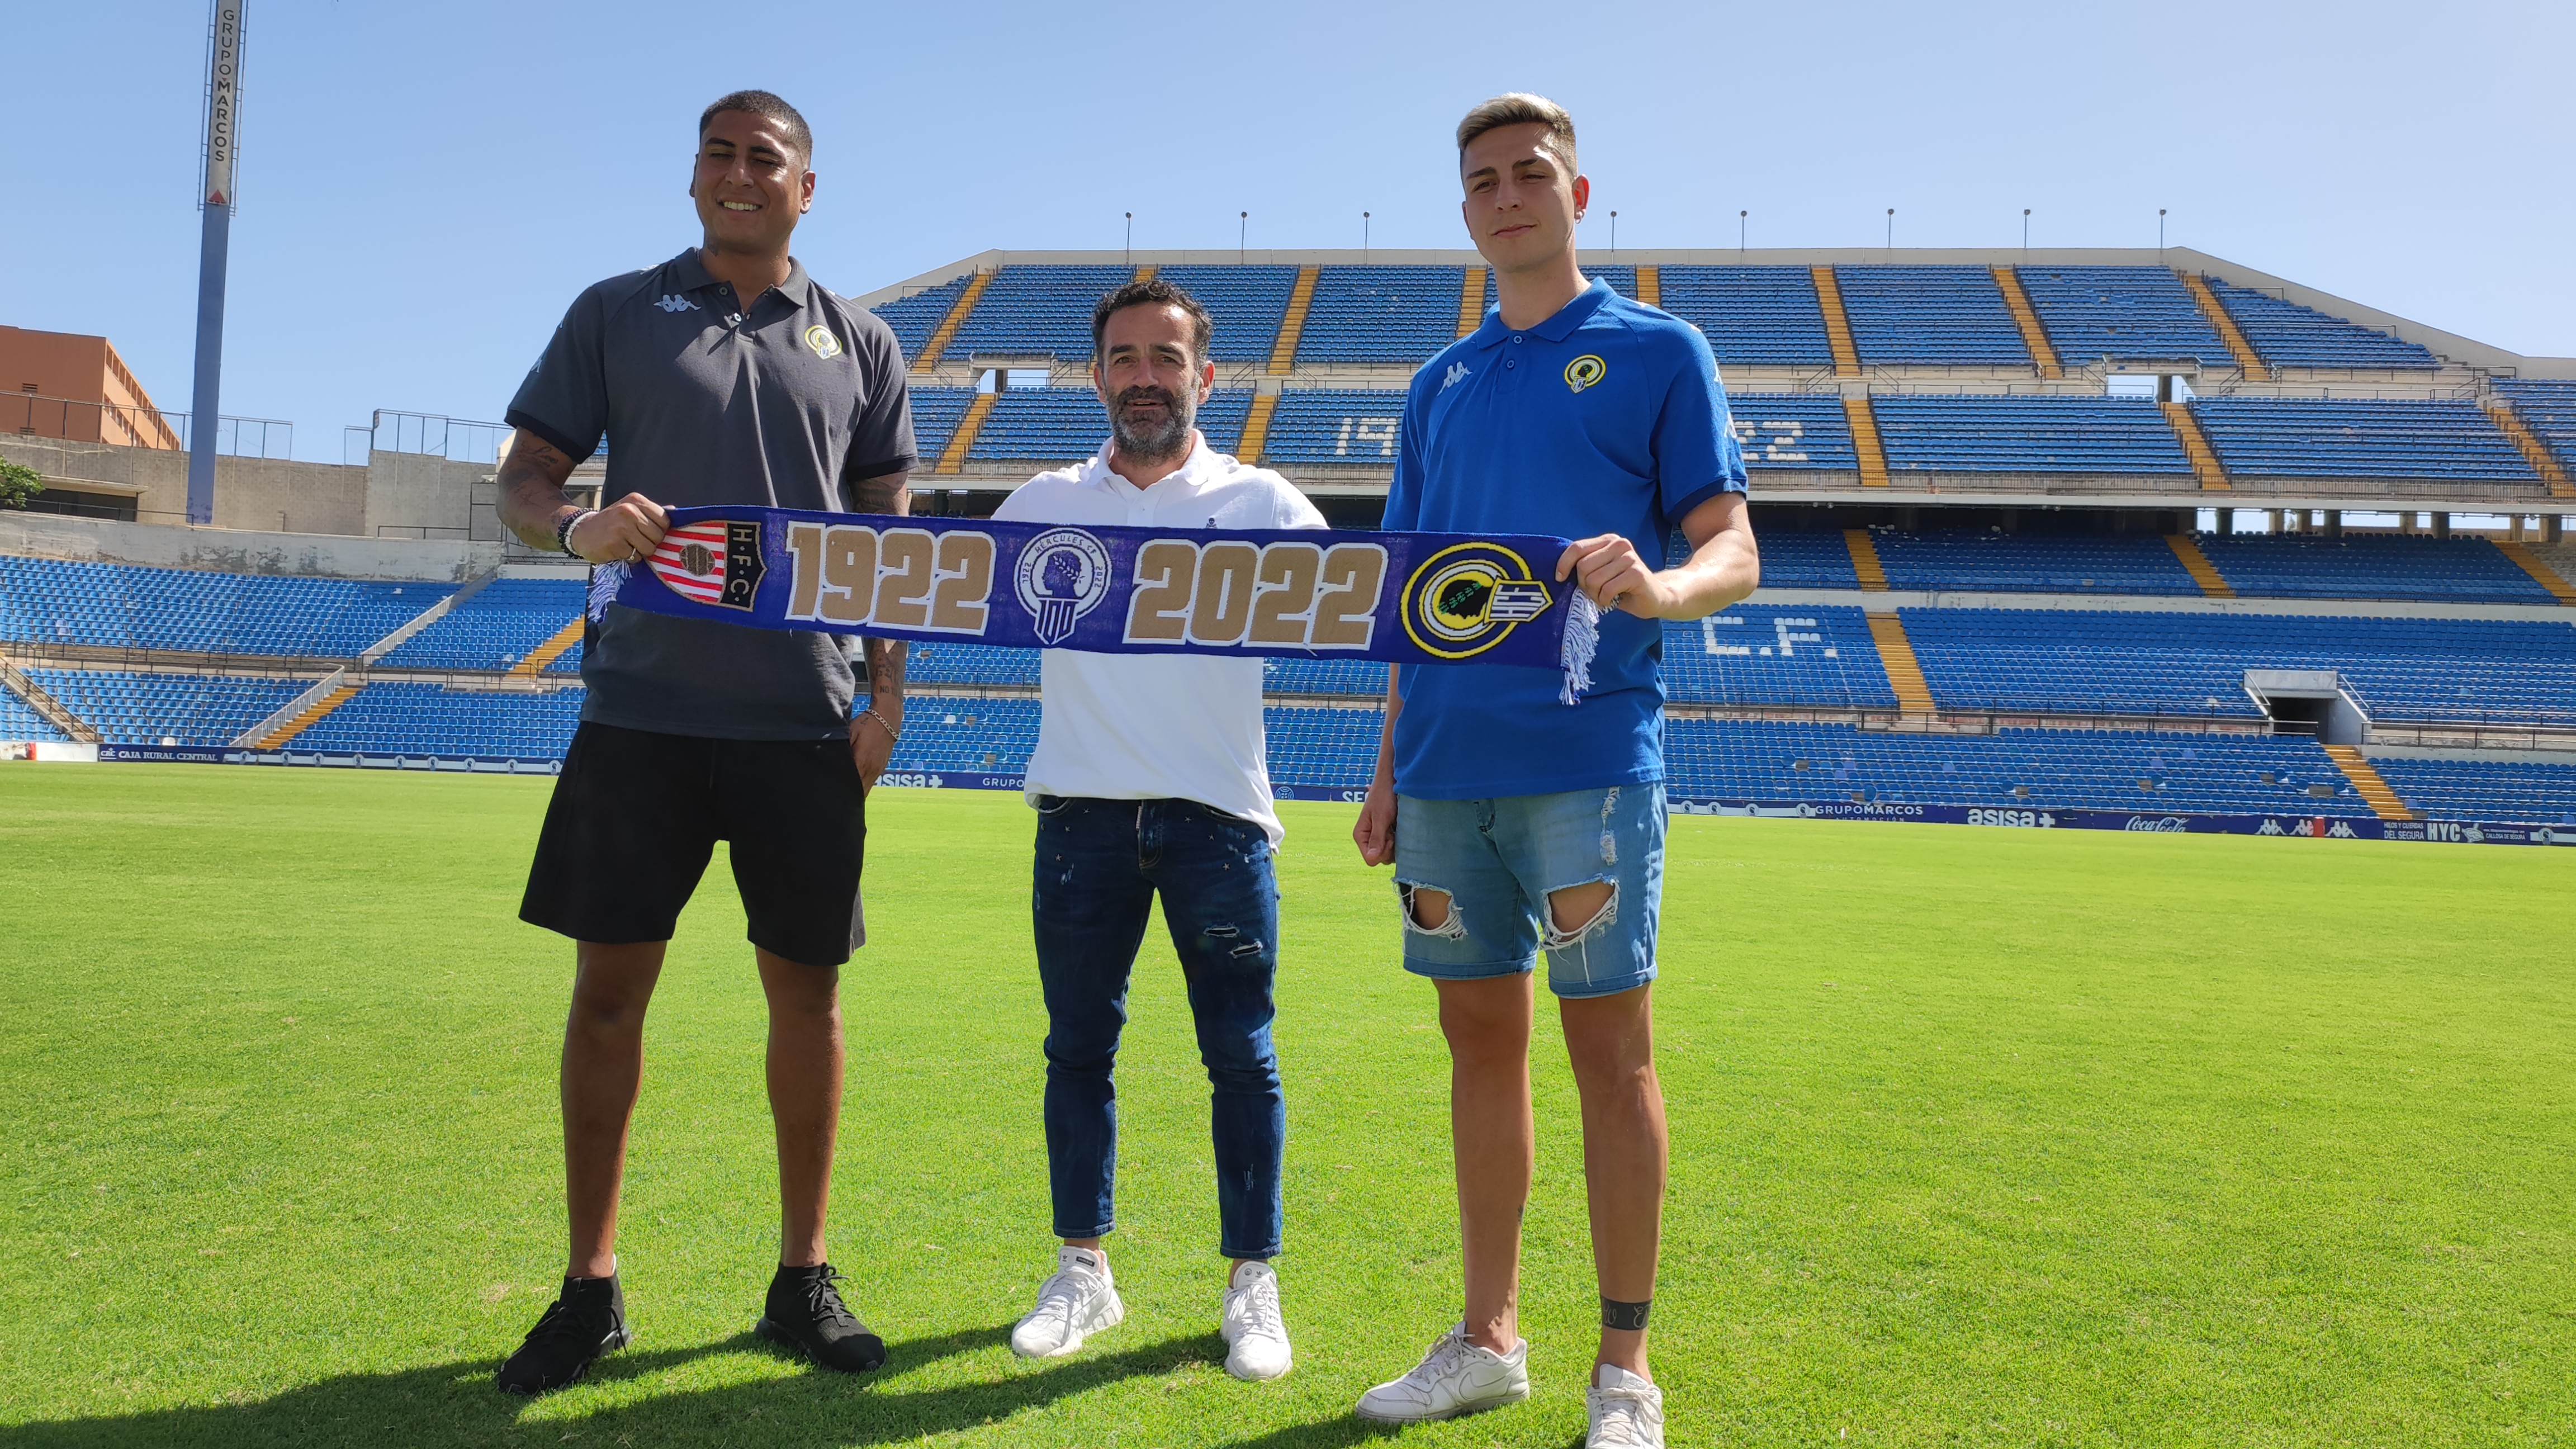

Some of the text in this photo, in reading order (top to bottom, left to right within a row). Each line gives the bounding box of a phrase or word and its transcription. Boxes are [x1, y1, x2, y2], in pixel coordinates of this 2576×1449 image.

[784, 520, 996, 636] 1922
[1022, 562, 1031, 584] 1922
[1095, 566, 1103, 588] 2022
[1122, 538, 1389, 650] 2022
[177, 753, 217, 761] CENTRAL
[1815, 805, 1923, 816] GRUPOMARCOS
[1967, 808, 2035, 827] asisa
[2384, 830, 2425, 840] DEL SEGURA
[2427, 823, 2460, 842] HYC
